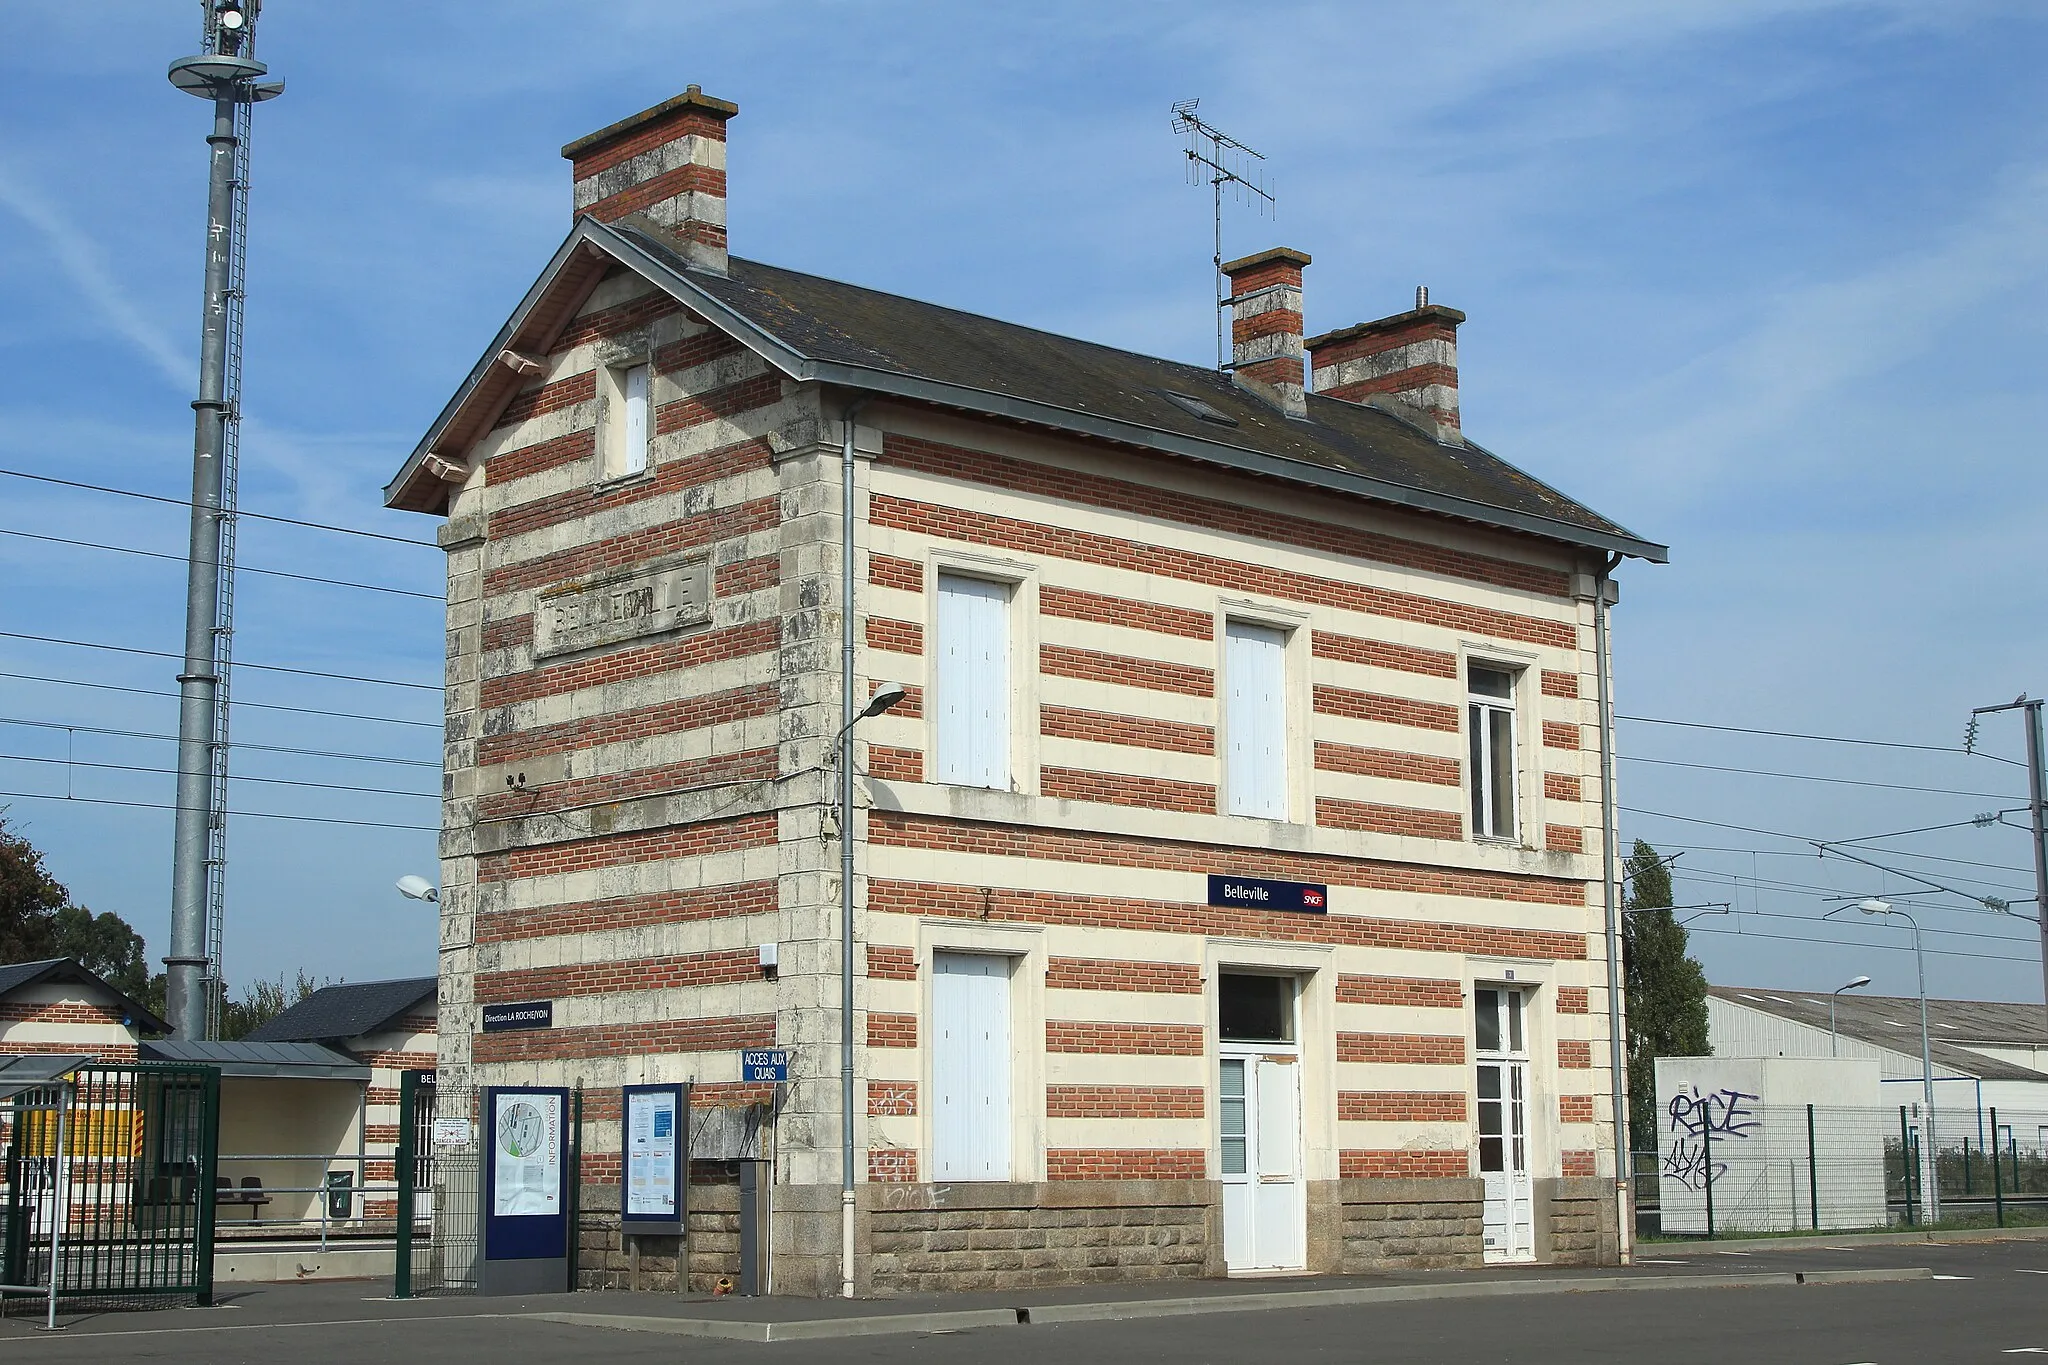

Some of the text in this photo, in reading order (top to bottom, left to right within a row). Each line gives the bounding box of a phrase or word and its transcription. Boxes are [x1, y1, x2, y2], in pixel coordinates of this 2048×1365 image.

[1224, 884, 1269, 901] Belleville
[1303, 894, 1323, 905] SNCF
[484, 1013, 507, 1023] Direction
[507, 1011, 515, 1021] LA
[744, 1052, 786, 1066] ACCES AUX
[420, 1074, 436, 1084] BEL
[754, 1066, 776, 1080] QUAIS
[548, 1096, 556, 1166] INFORMATION
